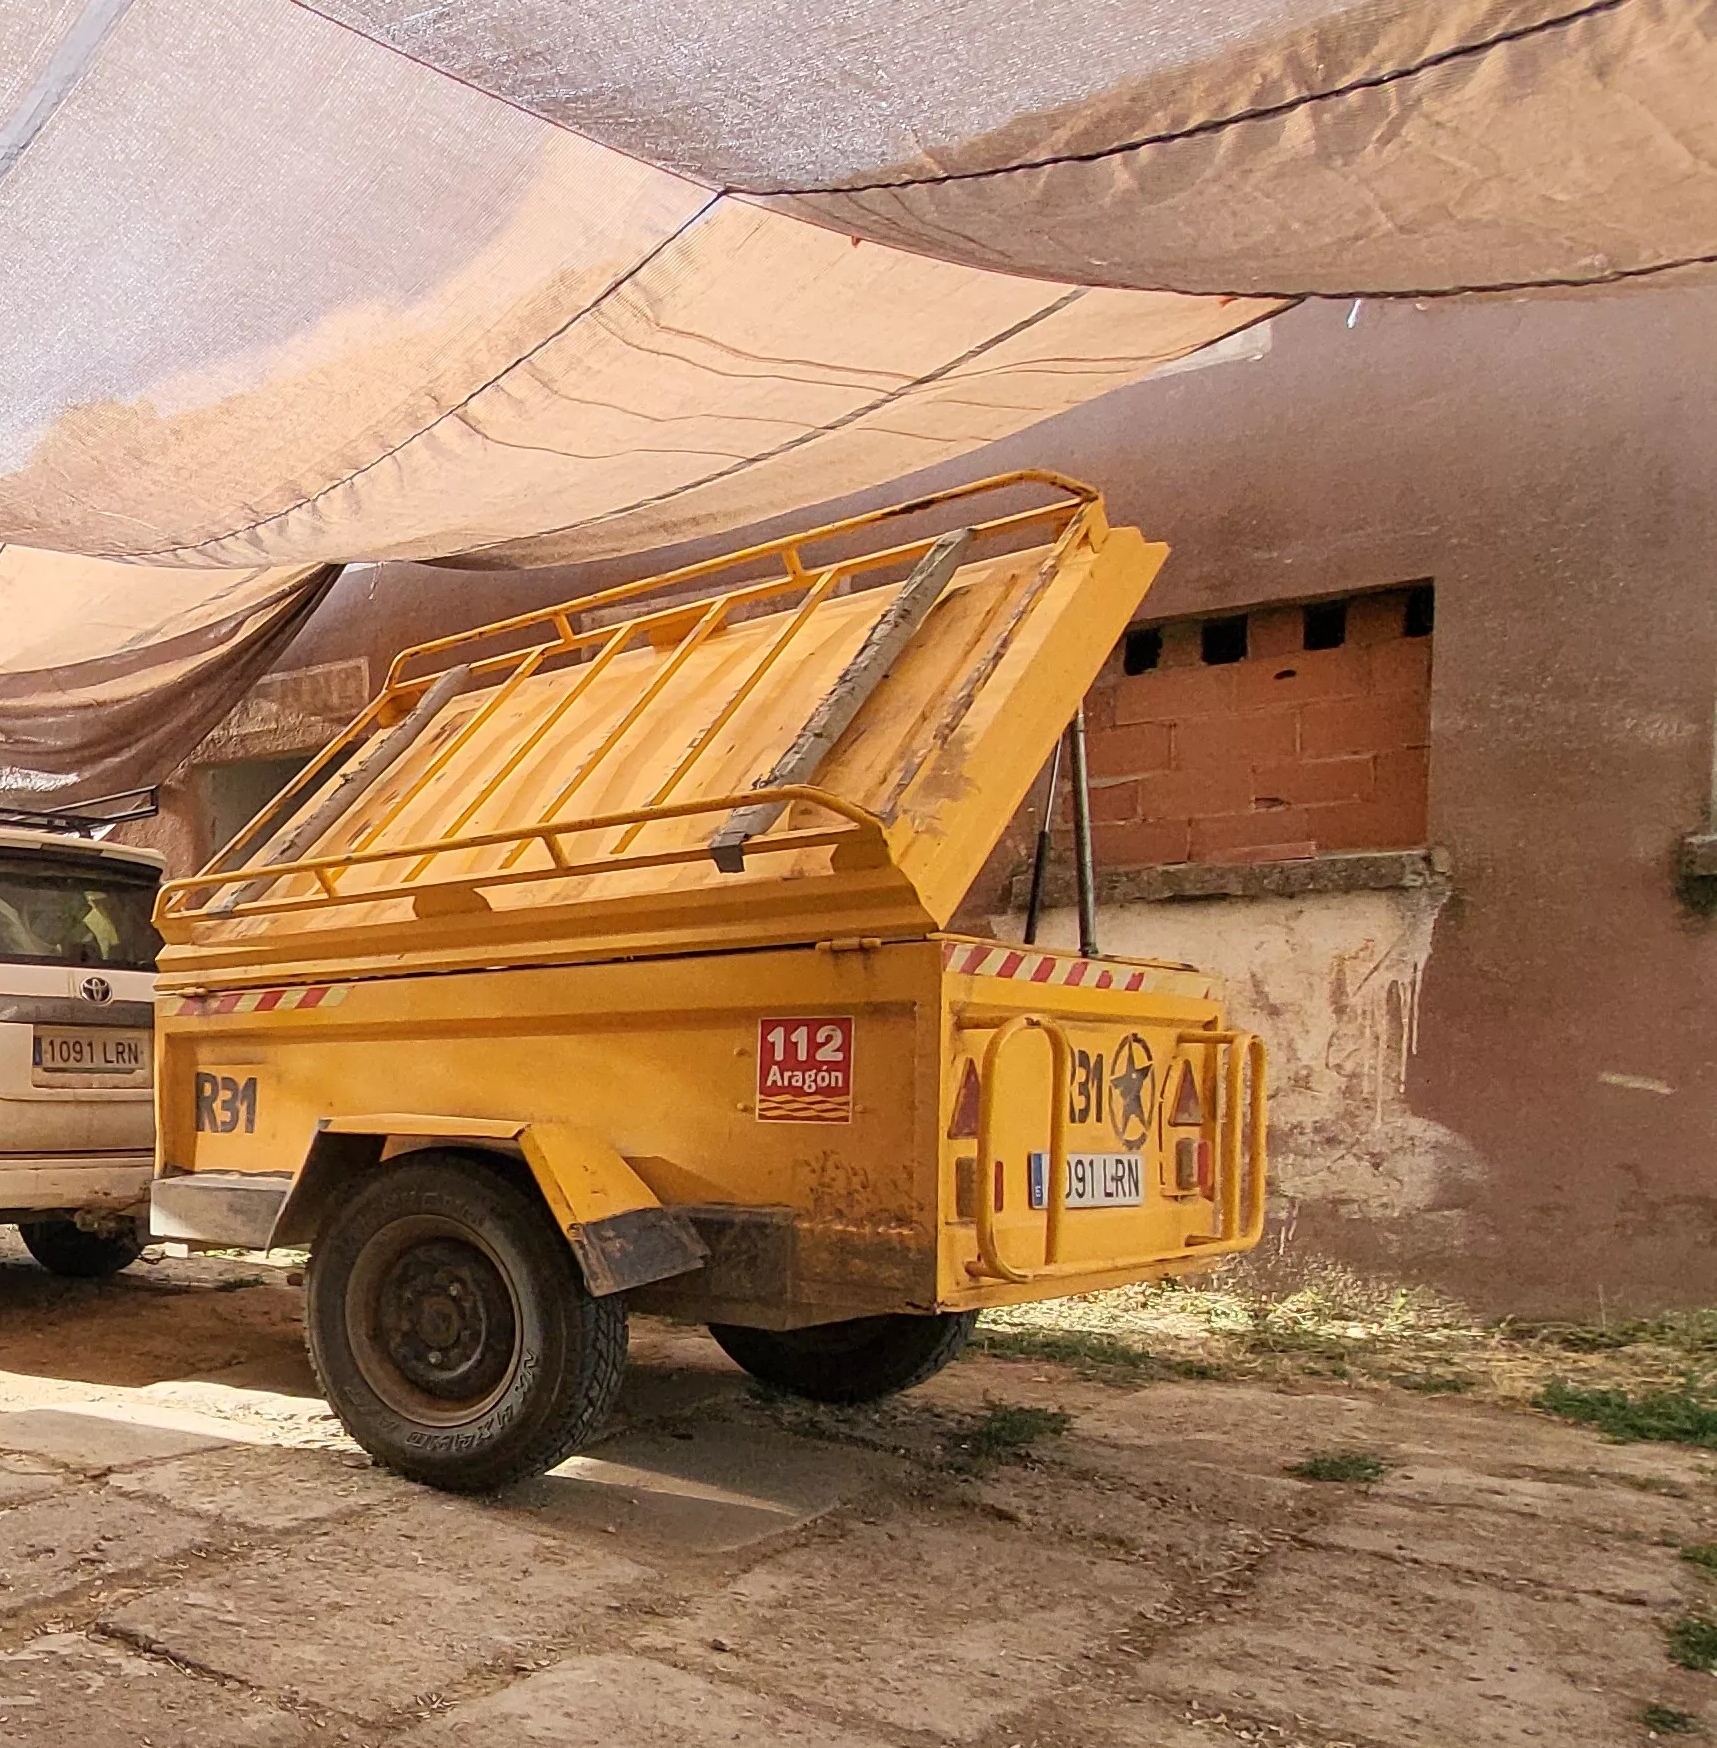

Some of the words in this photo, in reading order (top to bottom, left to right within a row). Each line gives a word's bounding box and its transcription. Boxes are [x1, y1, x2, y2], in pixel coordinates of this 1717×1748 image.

[48, 1039, 94, 1063] 1091
[103, 1040, 139, 1064] LRN
[767, 1025, 844, 1062] 112
[766, 1065, 844, 1093] Aragón
[195, 1071, 258, 1134] R31
[1103, 1158, 1139, 1197] LRN
